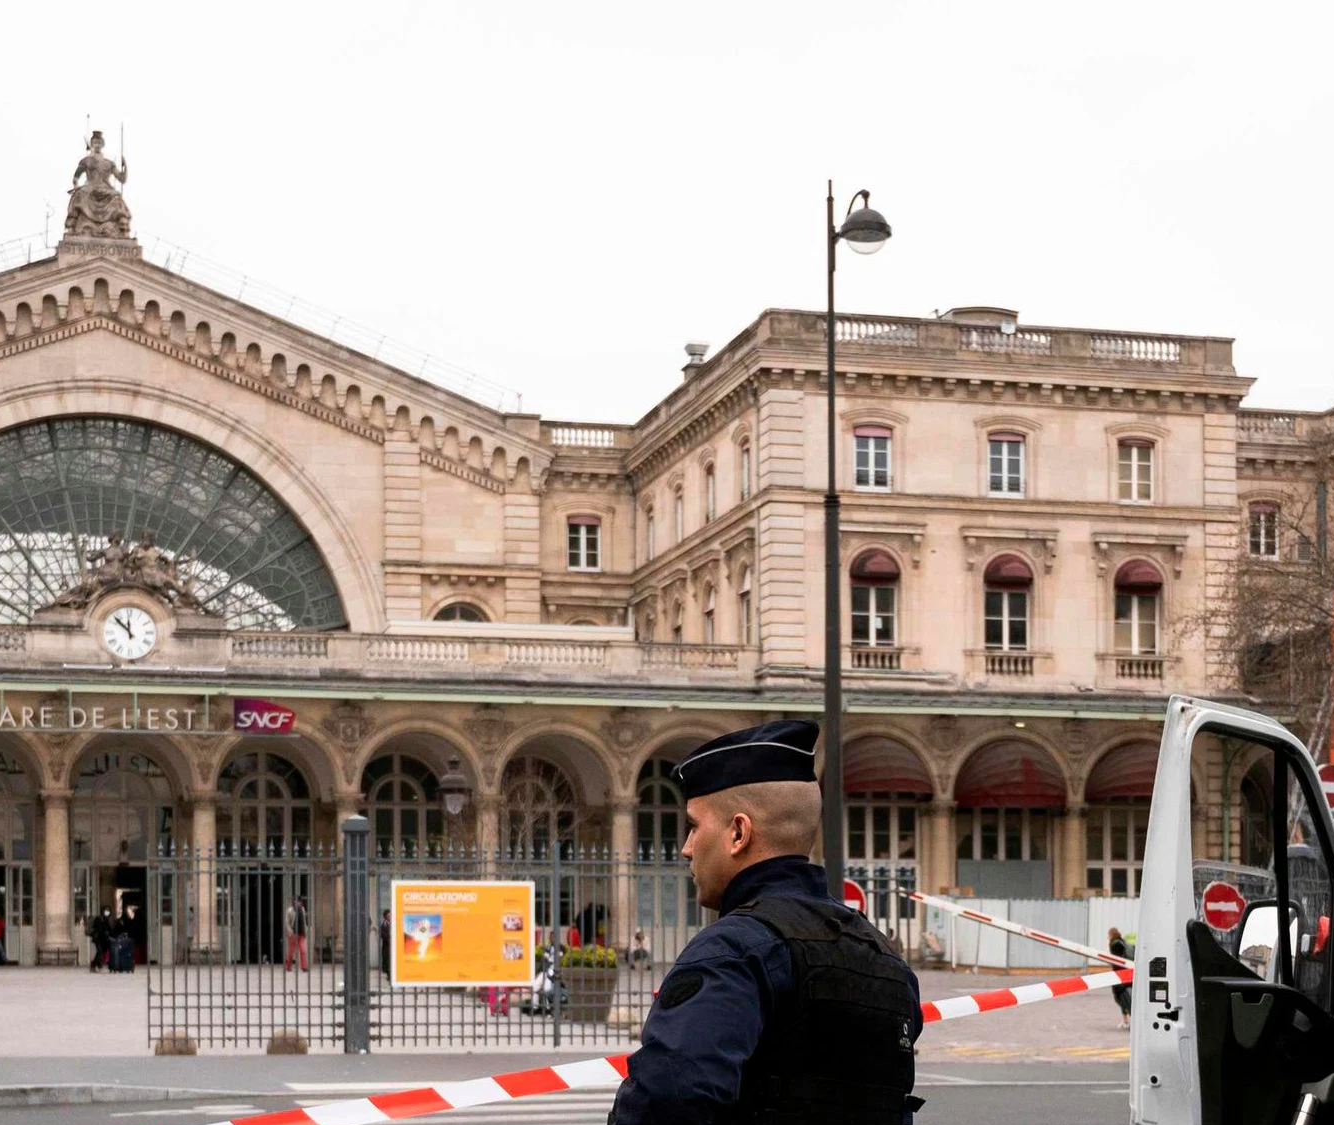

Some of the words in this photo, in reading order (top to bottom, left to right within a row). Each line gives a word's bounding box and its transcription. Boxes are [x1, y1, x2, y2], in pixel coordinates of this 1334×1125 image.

[71, 707, 104, 729] DE
[123, 708, 196, 730] L'EST
[236, 711, 293, 729] SNCF
